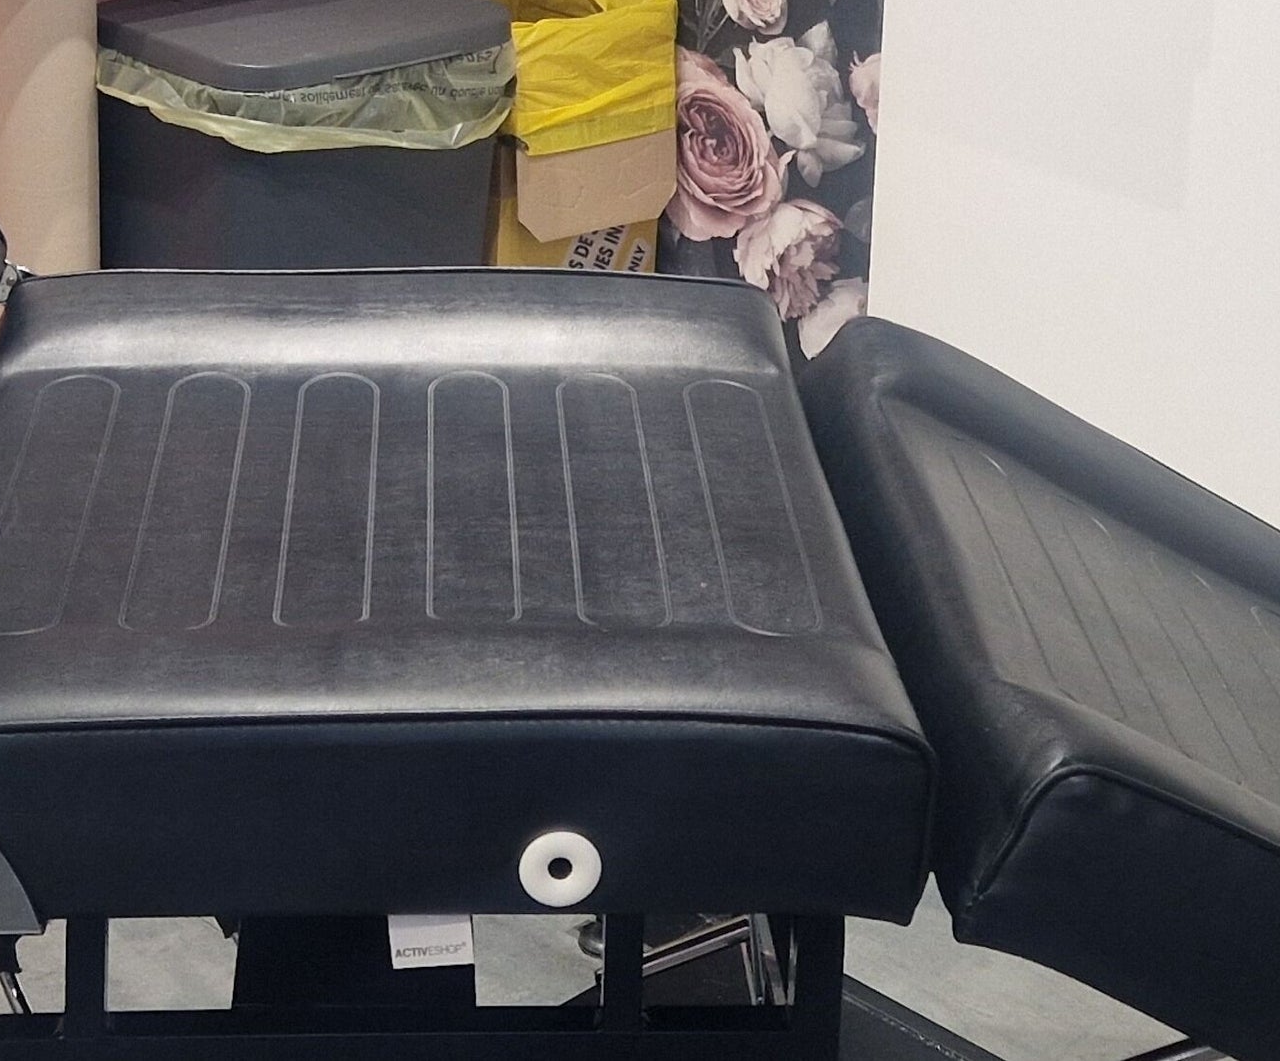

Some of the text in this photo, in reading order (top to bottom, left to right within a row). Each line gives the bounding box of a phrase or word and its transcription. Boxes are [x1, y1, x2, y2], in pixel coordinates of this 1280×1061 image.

[573, 235, 594, 259] DE
[627, 243, 646, 273] NLY
[395, 944, 462, 959] ACTIVESHOP
